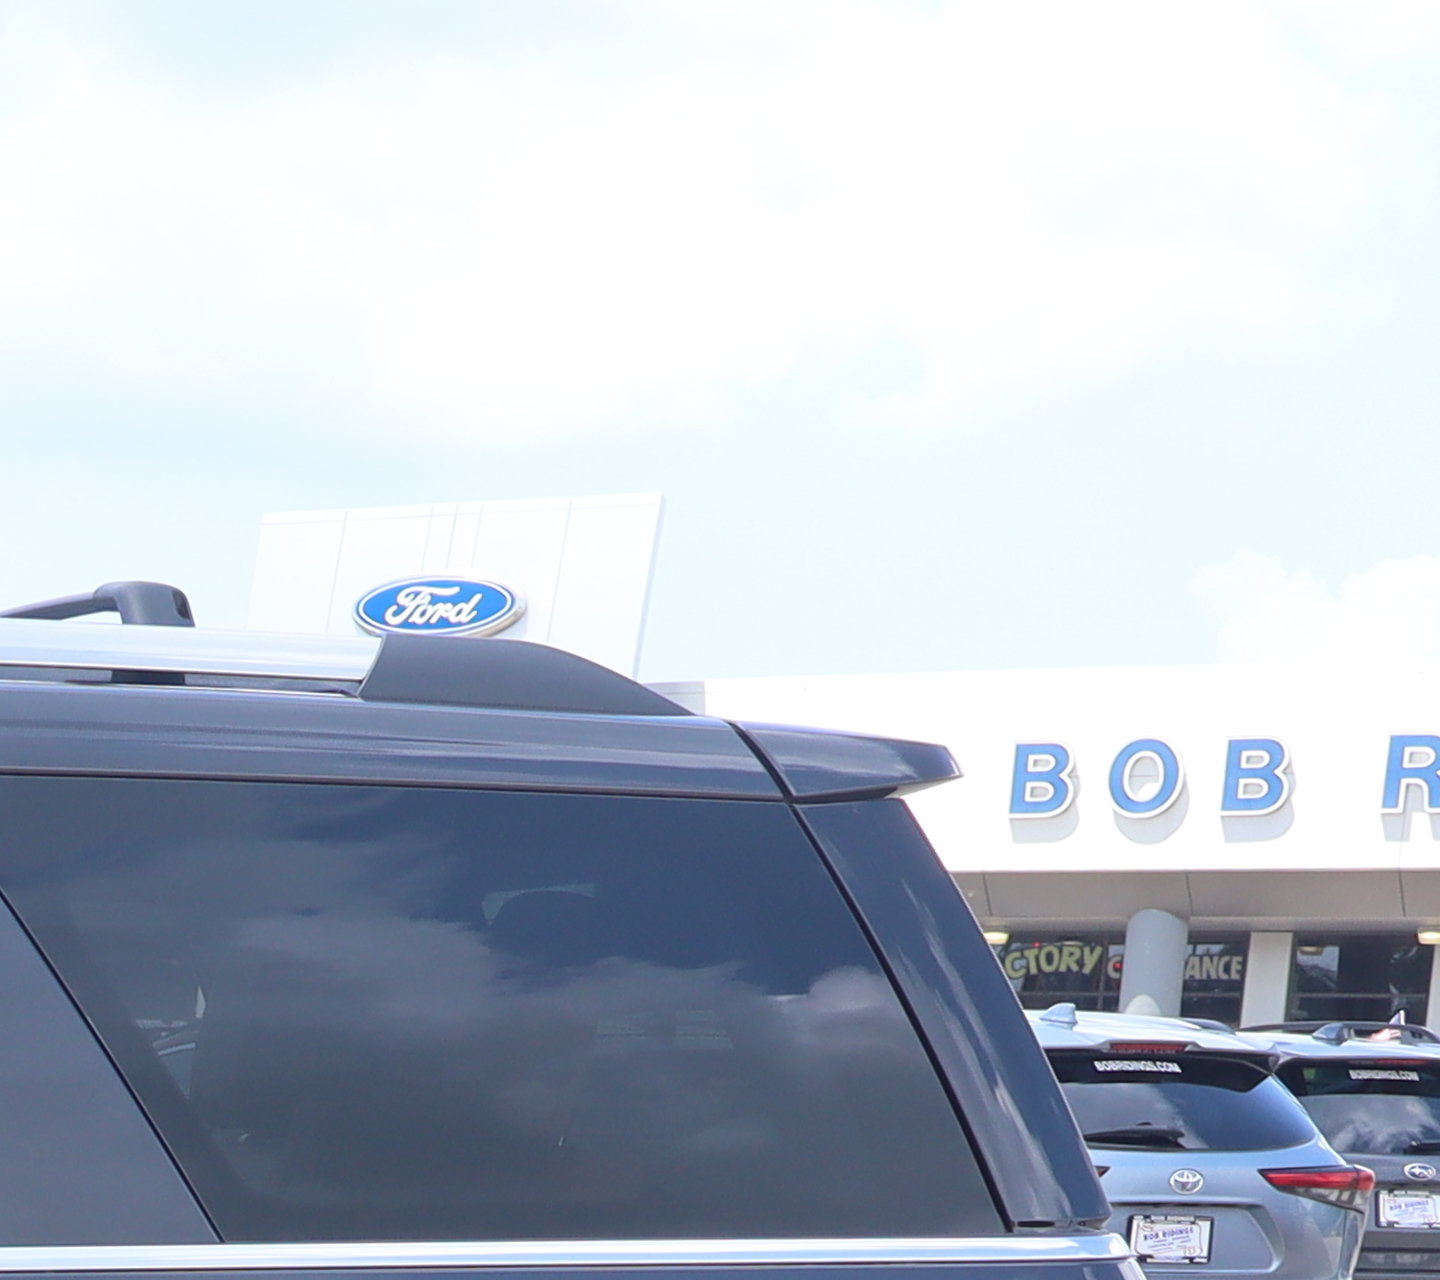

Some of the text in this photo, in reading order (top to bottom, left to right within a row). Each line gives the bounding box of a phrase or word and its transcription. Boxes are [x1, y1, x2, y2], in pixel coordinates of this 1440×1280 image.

[383, 585, 484, 626] Ford
[1008, 736, 1292, 819] BOB
[1005, 943, 1103, 980] CTORY
